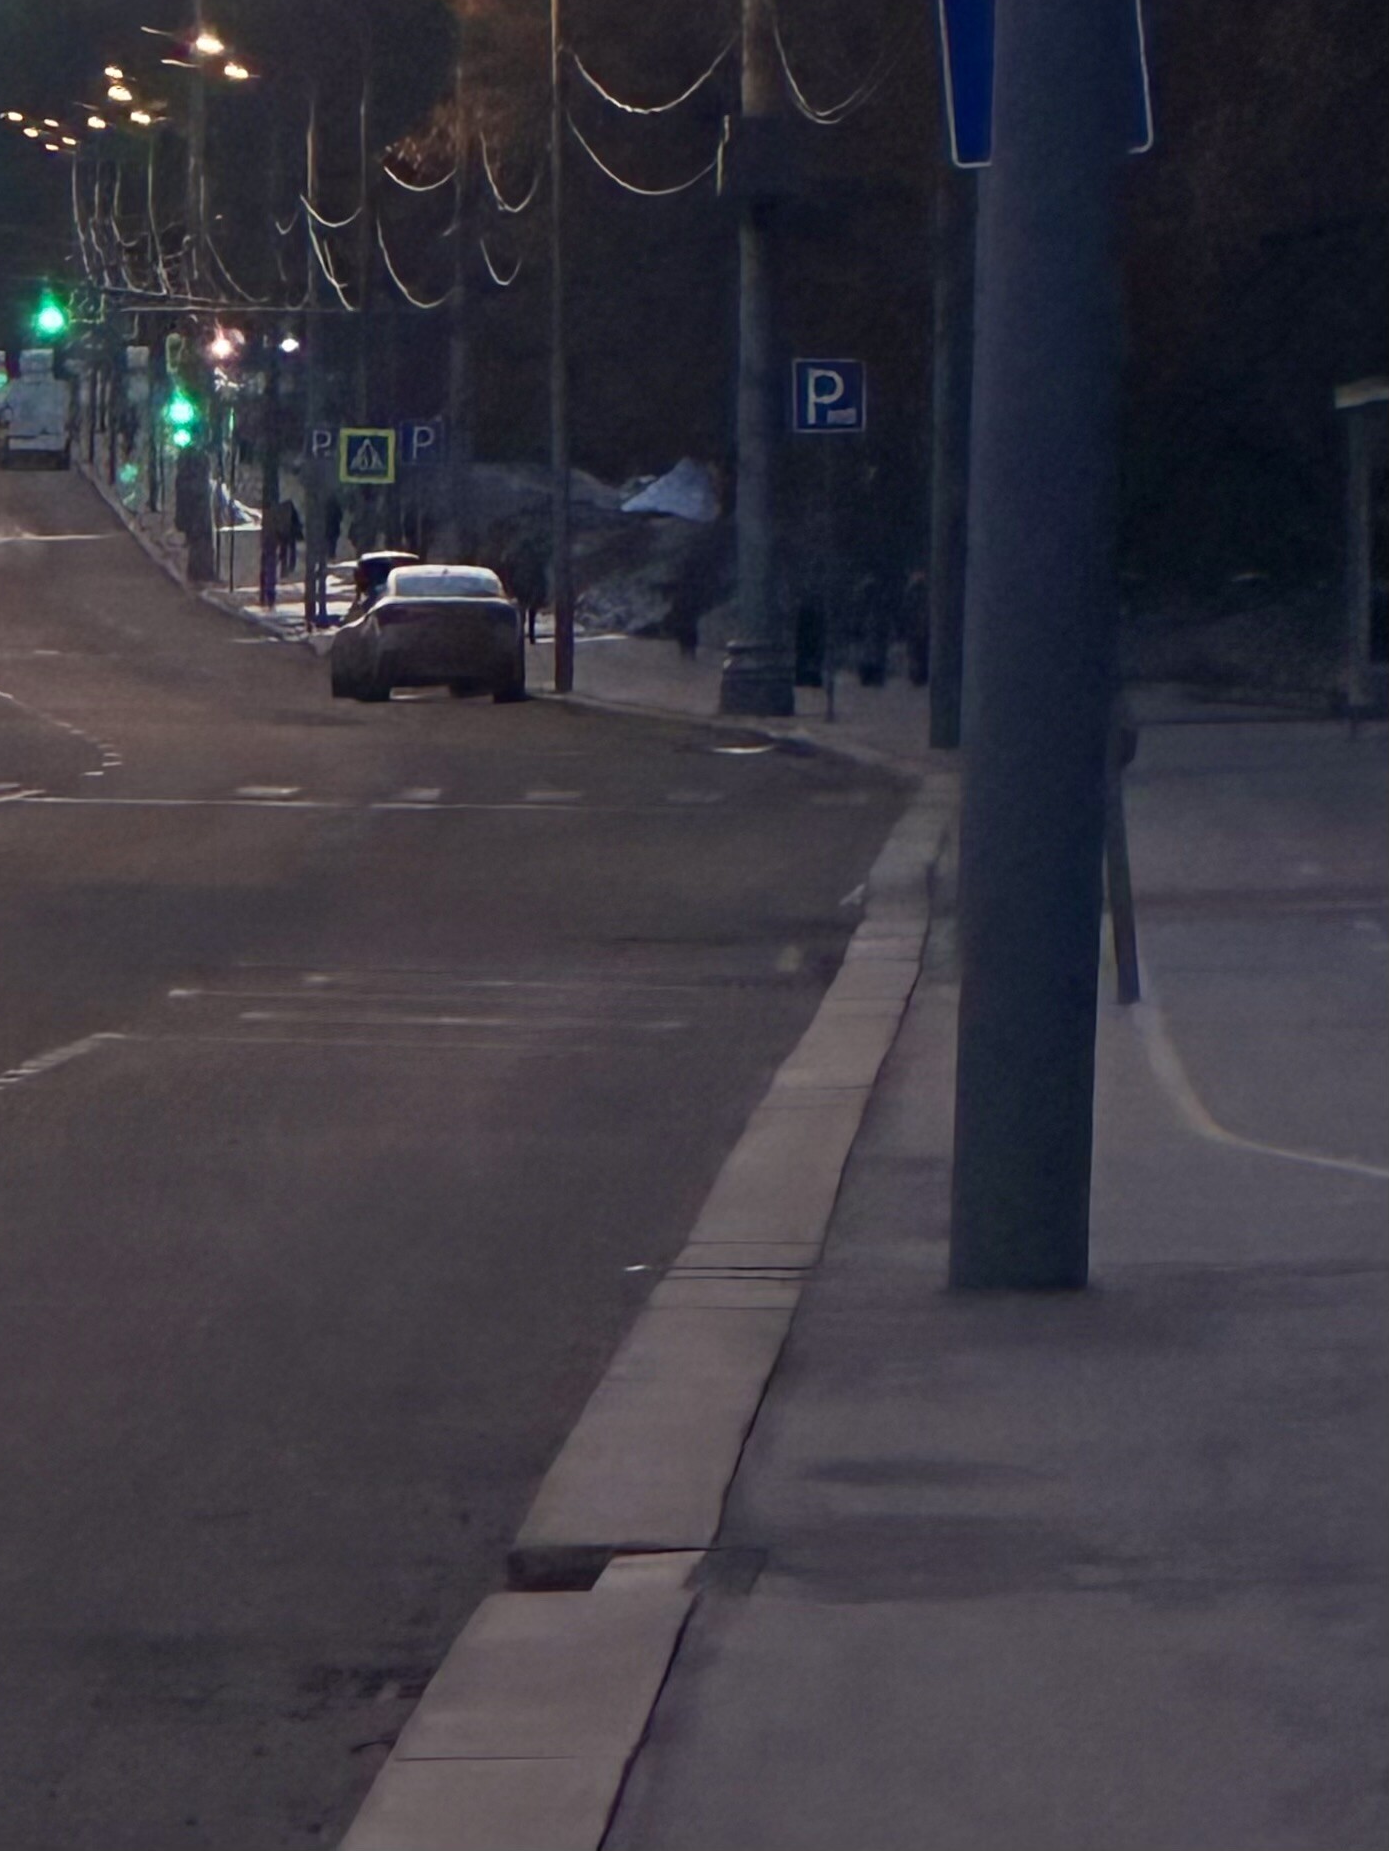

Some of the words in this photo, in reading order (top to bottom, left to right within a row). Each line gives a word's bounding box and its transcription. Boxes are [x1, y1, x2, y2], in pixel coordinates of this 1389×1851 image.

[807, 367, 845, 425] P
[312, 429, 332, 459] P
[412, 426, 435, 459] P
